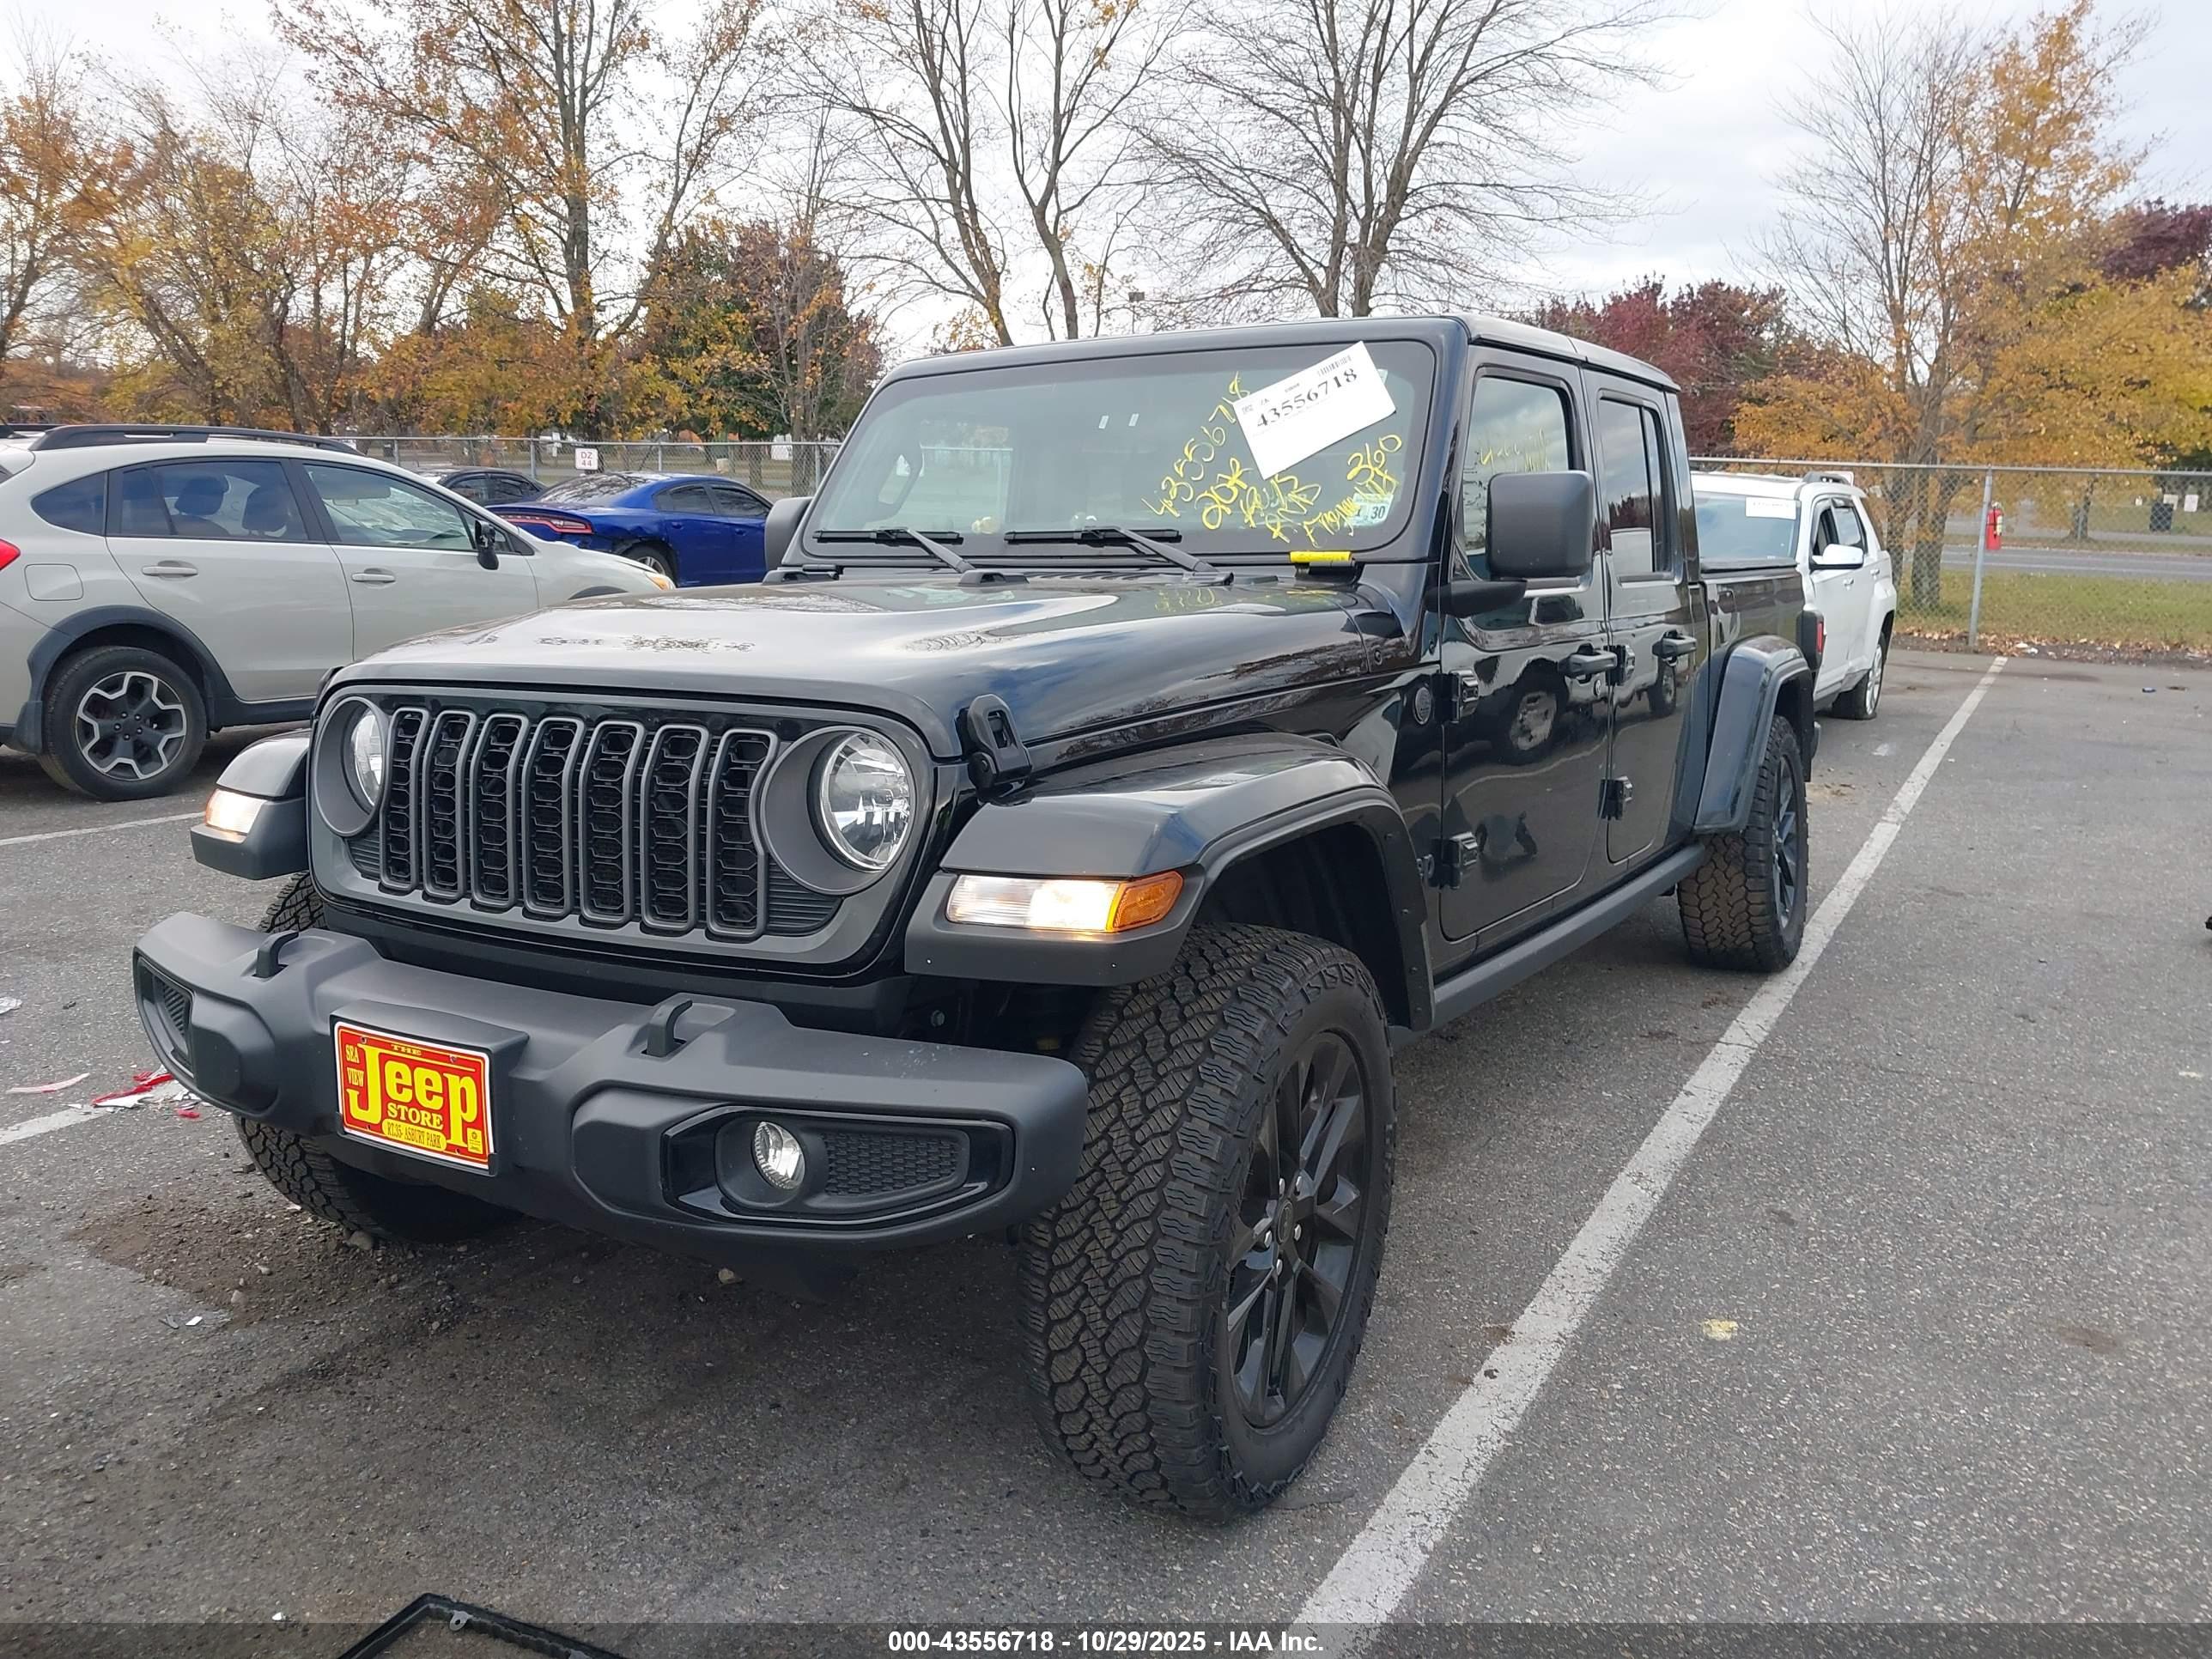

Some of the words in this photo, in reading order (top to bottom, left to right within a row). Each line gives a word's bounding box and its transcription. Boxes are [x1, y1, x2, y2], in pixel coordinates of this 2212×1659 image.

[1256, 368, 1358, 428] 43556718
[1370, 506, 1386, 520] 30
[345, 1044, 360, 1063] SEA
[392, 1044, 422, 1056] THE
[347, 1067, 364, 1087] VIEW
[347, 1043, 478, 1147] Jeep
[386, 1103, 443, 1130] STORE
[404, 1125, 426, 1144] ASBURY
[426, 1132, 442, 1149] PARK
